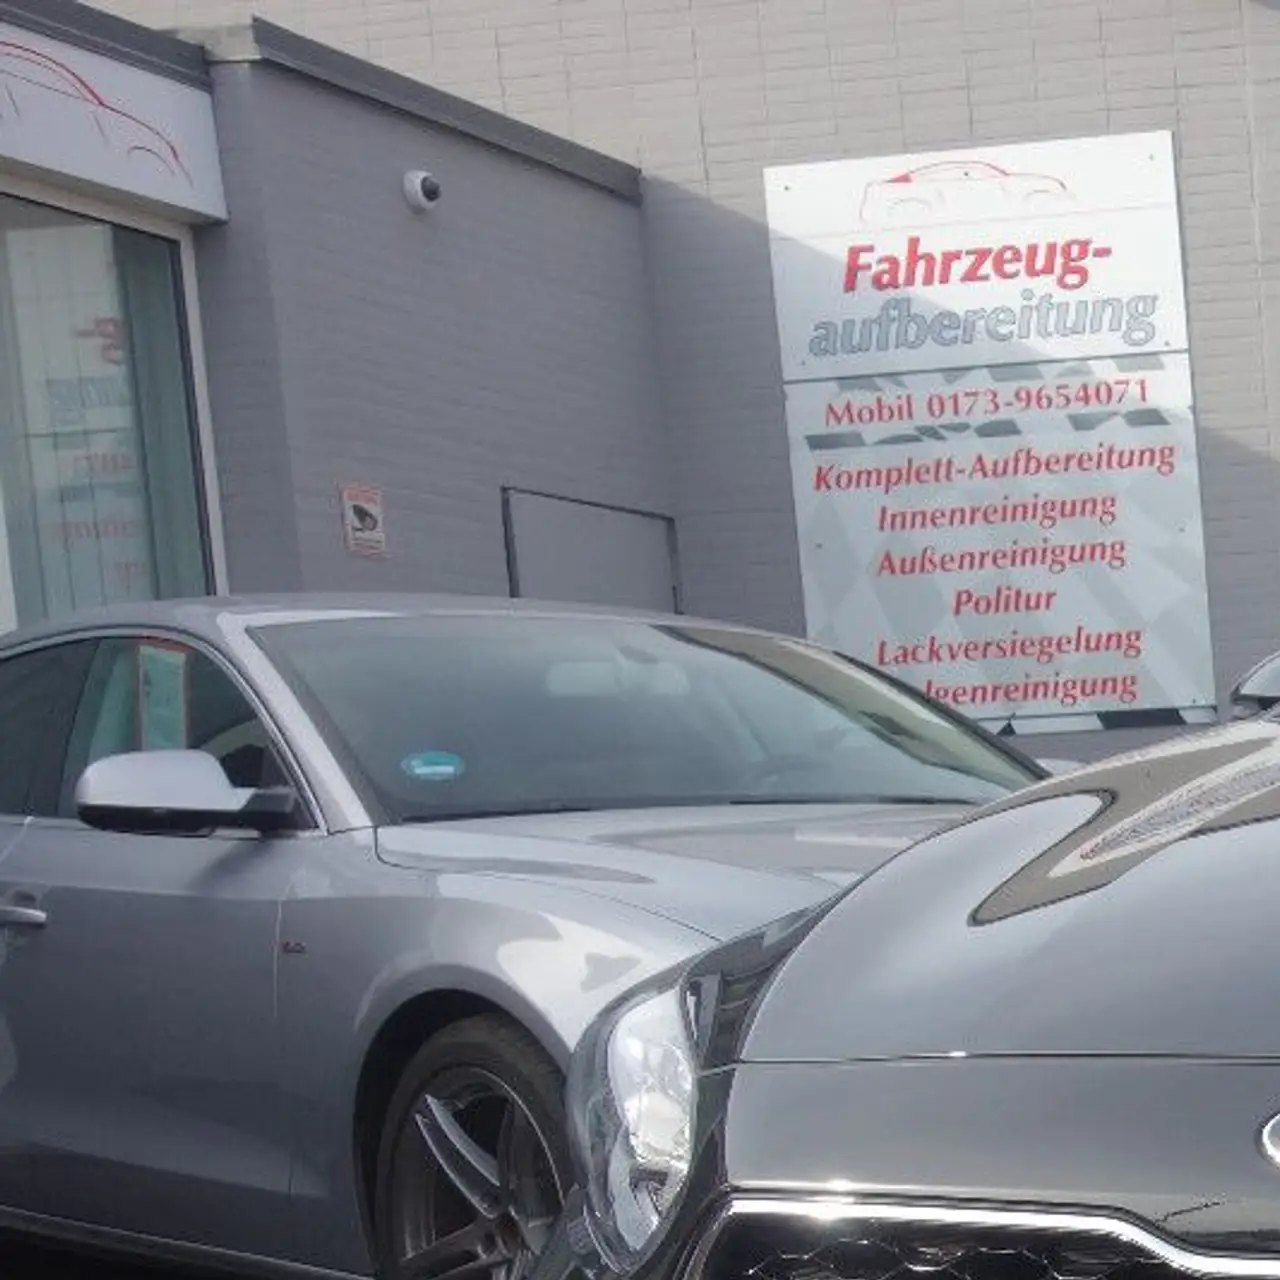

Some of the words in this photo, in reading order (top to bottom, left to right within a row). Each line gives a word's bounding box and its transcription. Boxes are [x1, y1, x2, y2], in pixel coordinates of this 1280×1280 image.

[842, 234, 1113, 291] Fahrzeug-
[808, 288, 1159, 356] aufbereitung
[826, 394, 914, 427] Mobil
[927, 378, 1149, 420] 0173-9654071
[814, 441, 1176, 494] Komplett-Aufbereitung
[877, 492, 1117, 533] Innenreinigung
[876, 537, 1126, 577] Außenreinigung
[952, 584, 1058, 617] Politur
[876, 624, 1142, 668] Lackversiegelung
